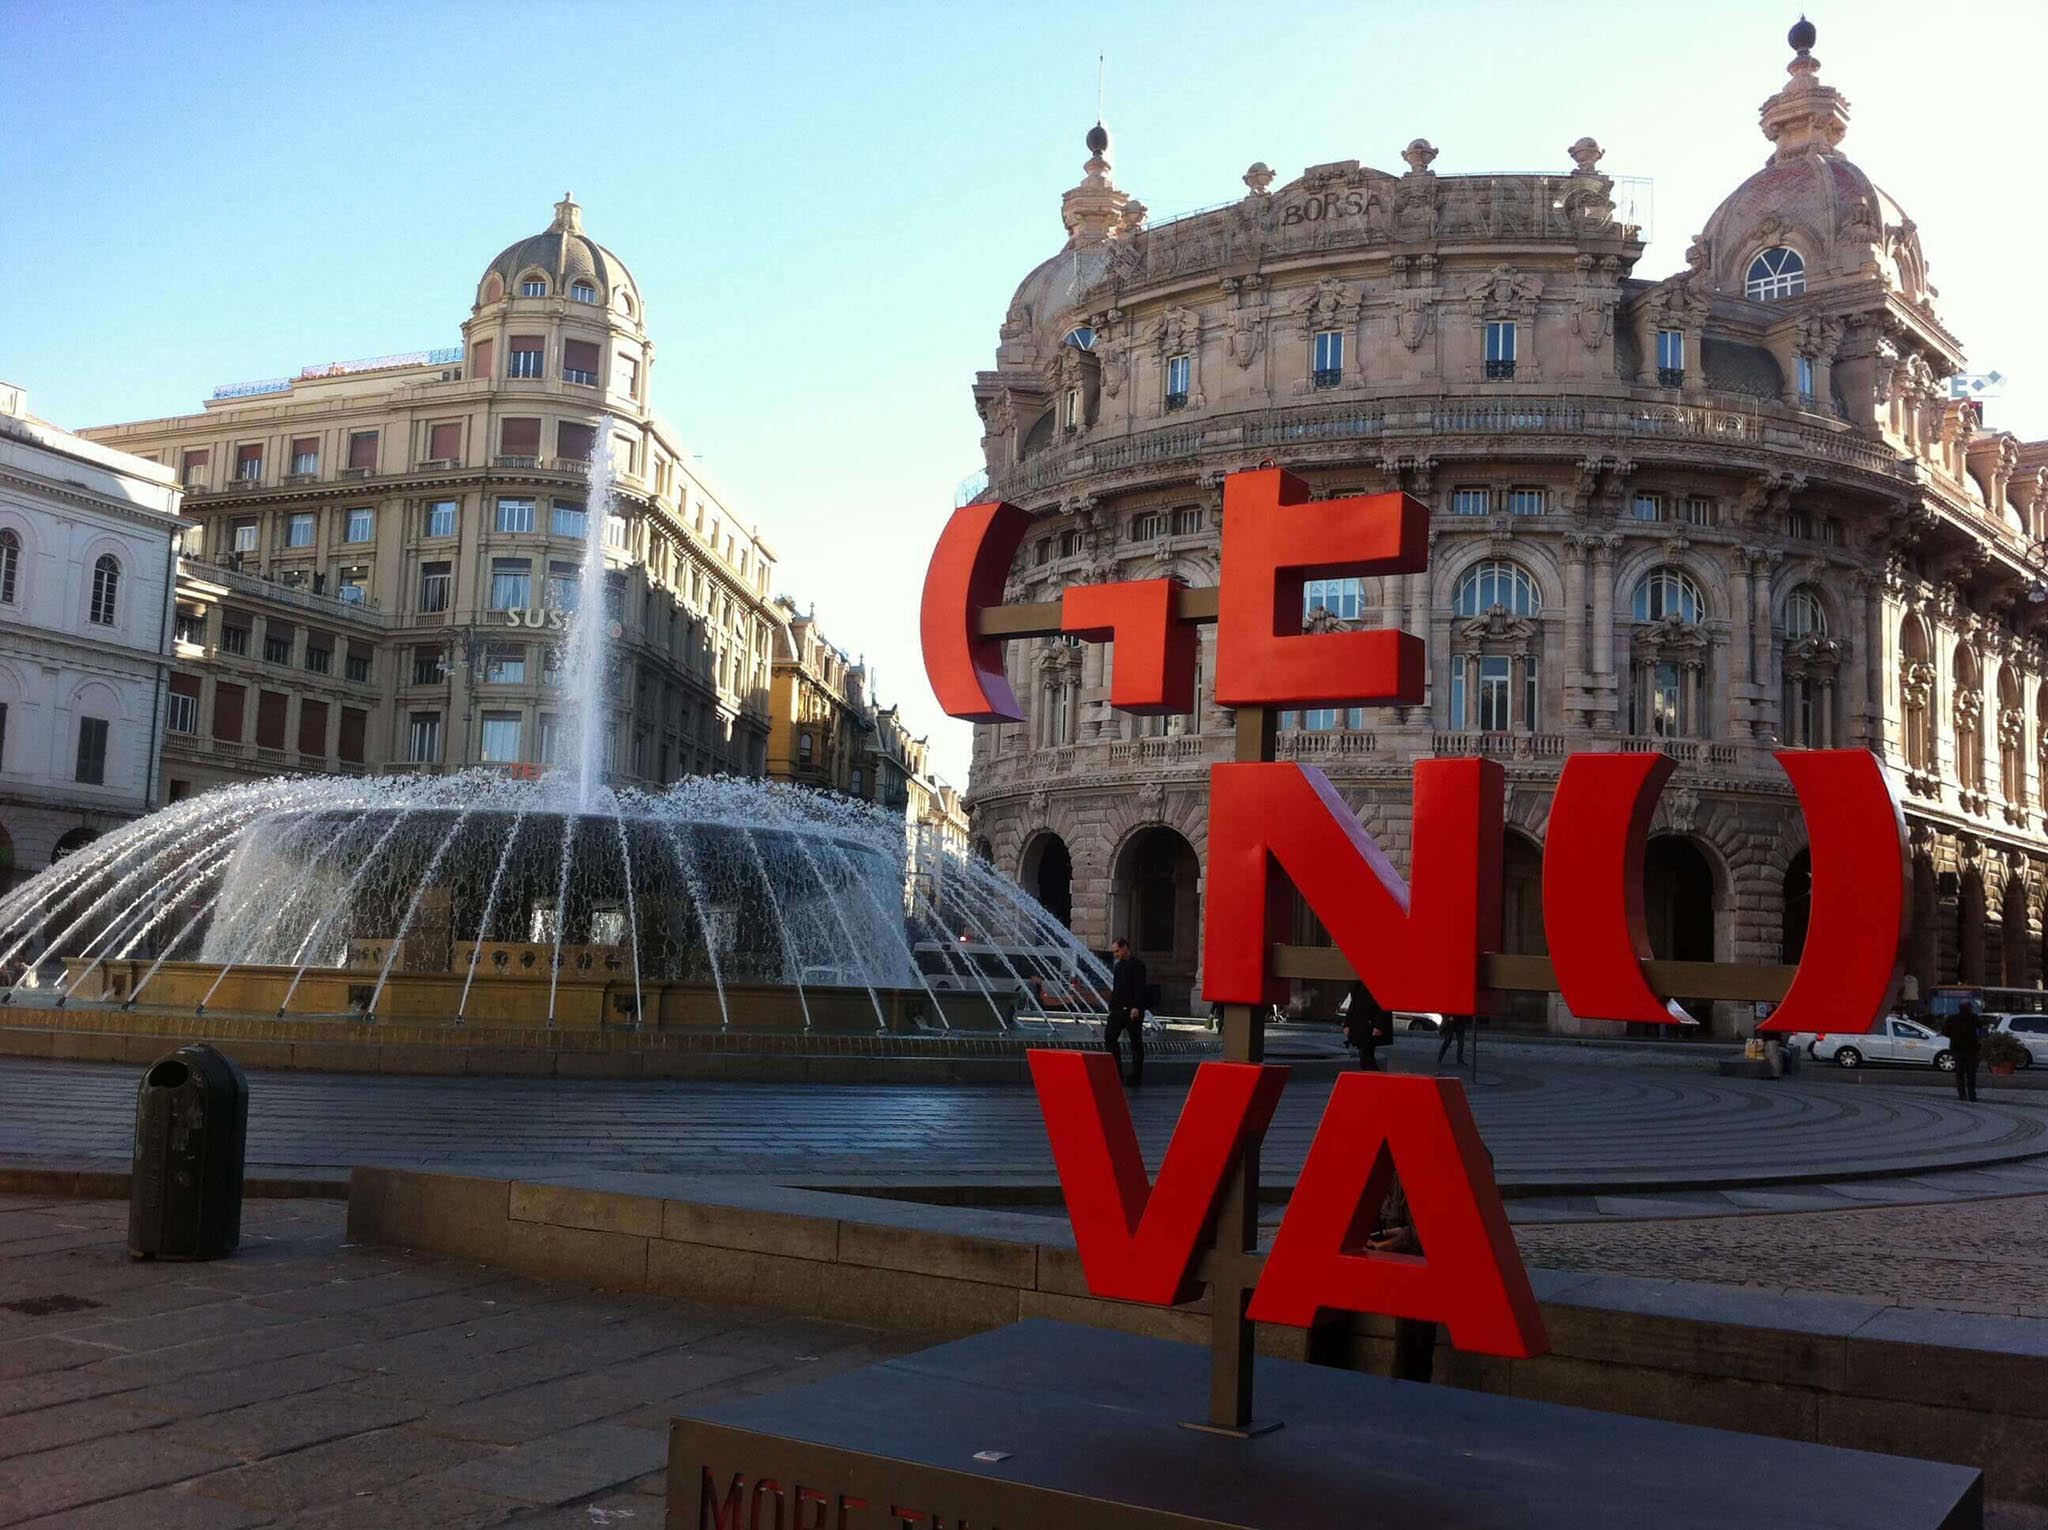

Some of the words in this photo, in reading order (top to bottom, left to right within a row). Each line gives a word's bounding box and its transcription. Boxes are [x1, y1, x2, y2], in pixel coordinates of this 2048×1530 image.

[1281, 191, 1383, 226] BORSA
[920, 467, 1430, 724] GE
[1027, 1048, 1549, 1358] VA
